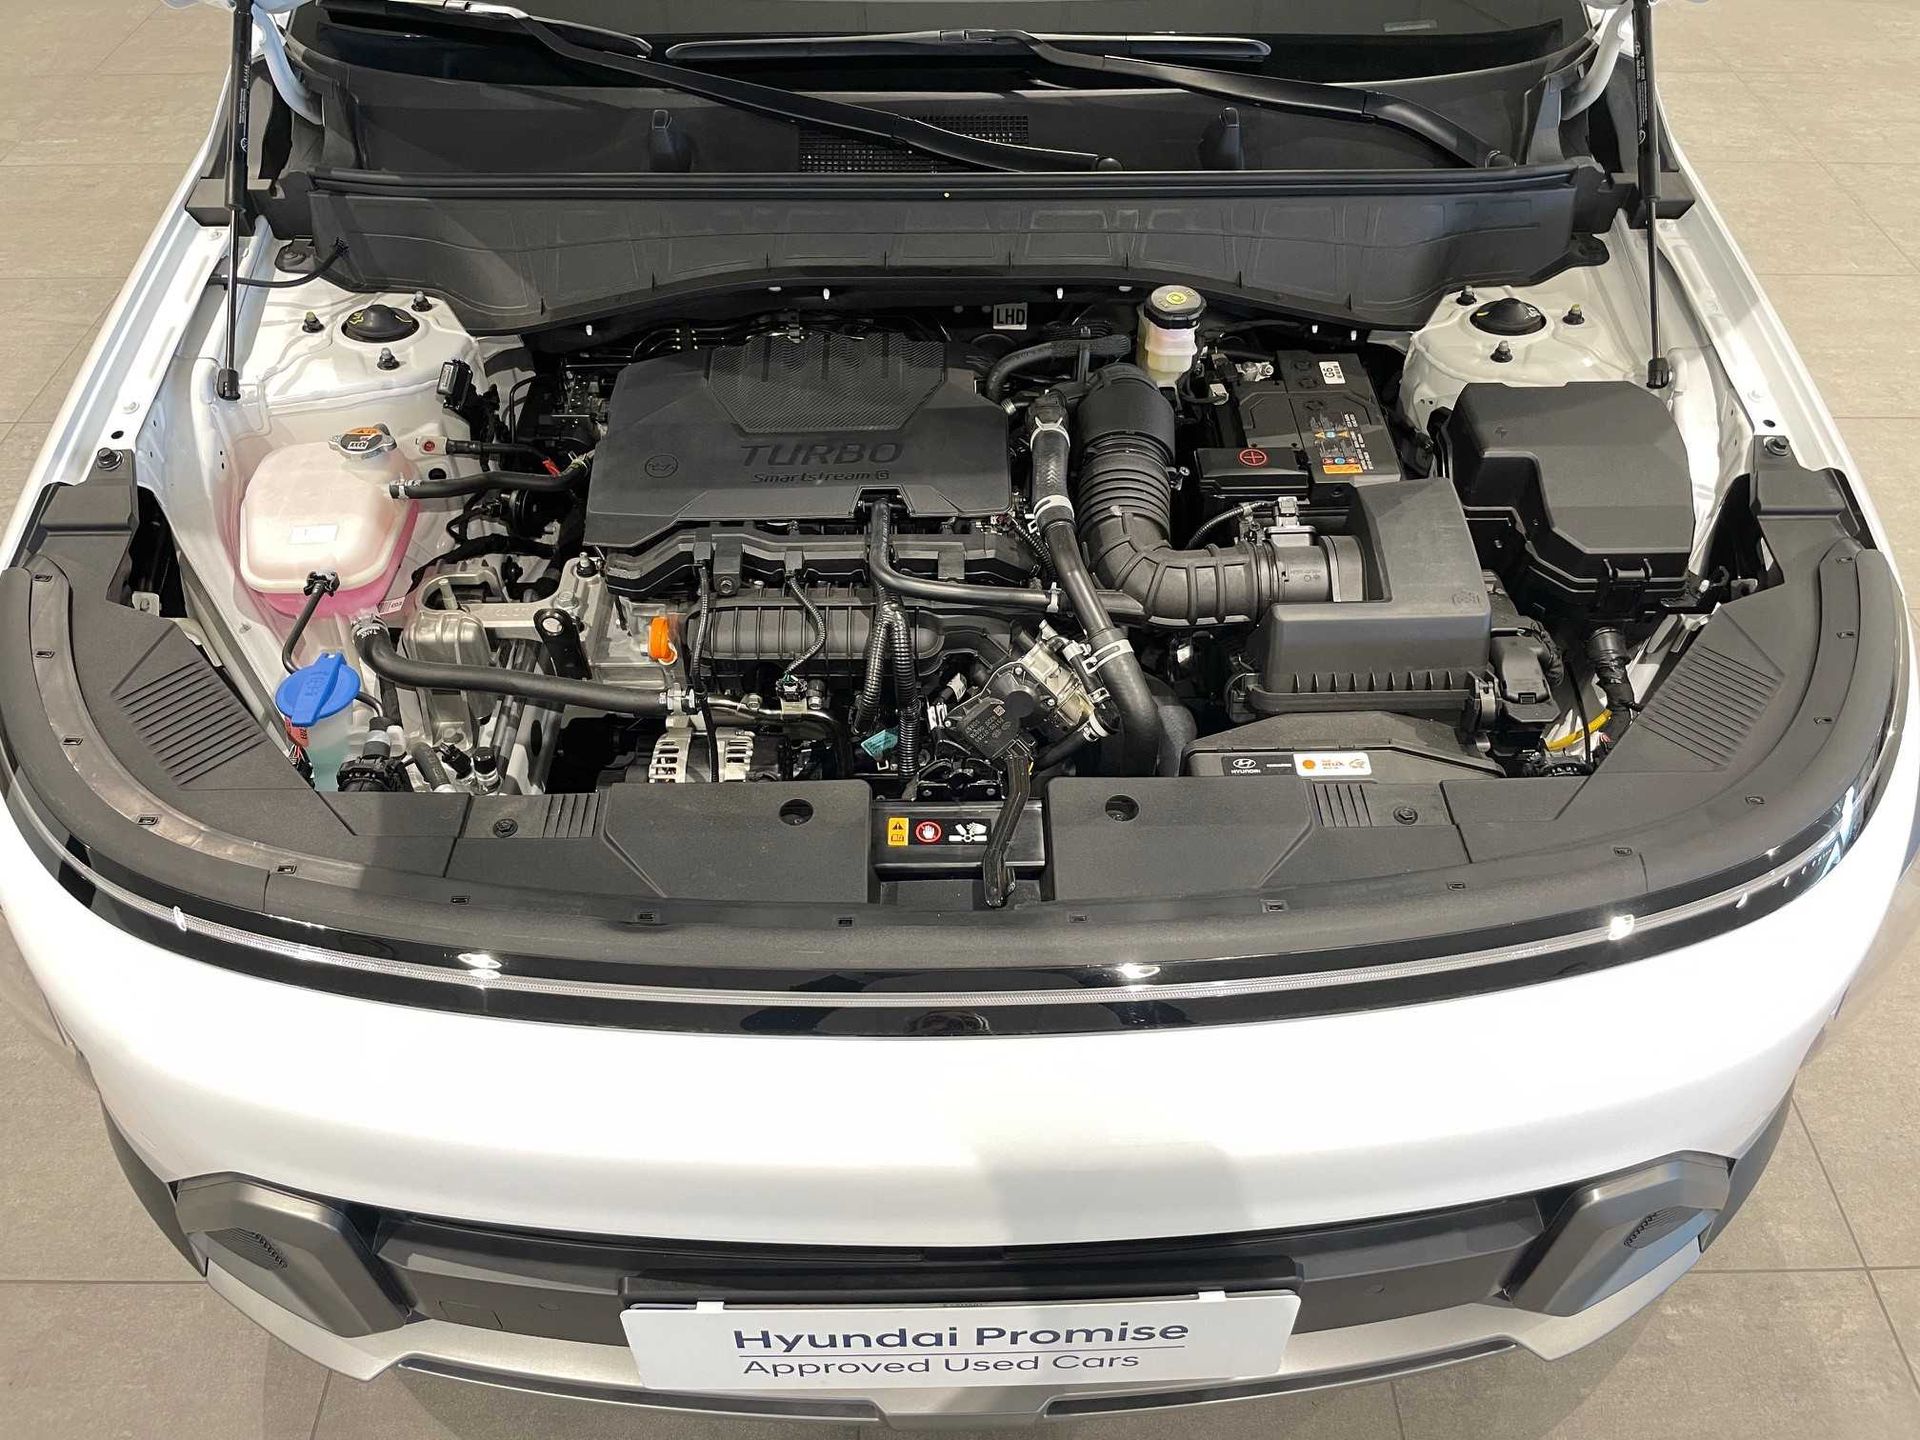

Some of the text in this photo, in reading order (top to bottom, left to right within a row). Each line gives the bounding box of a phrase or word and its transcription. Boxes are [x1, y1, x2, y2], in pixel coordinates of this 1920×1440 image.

[996, 308, 1026, 325] LHD
[740, 442, 902, 466] TURBO
[753, 471, 869, 483] Smartstream
[734, 1322, 1189, 1352] Hyundai Promise
[743, 1354, 1139, 1378] Approved Used Cars
